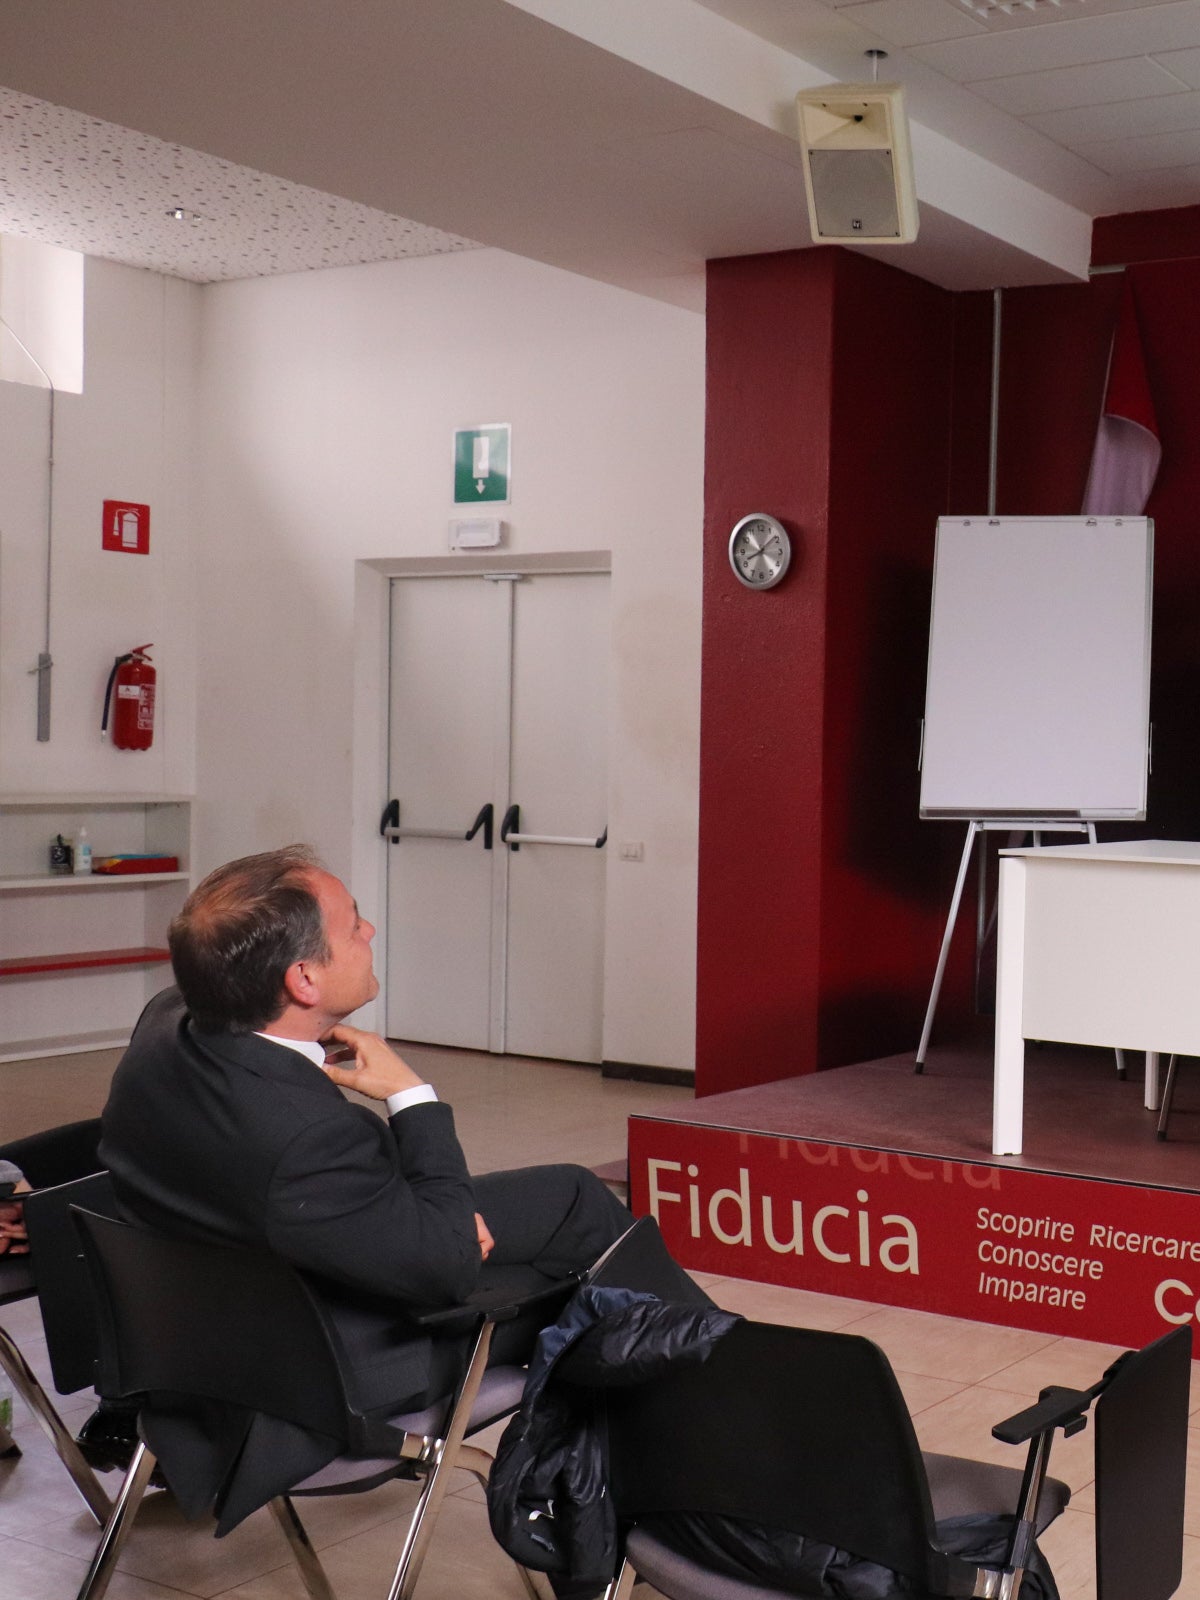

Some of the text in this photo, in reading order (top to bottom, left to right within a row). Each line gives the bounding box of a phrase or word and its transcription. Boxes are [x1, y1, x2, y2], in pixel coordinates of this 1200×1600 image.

[647, 1157, 920, 1276] Fiducia
[976, 1207, 1075, 1243] Scoprire
[977, 1240, 1104, 1280] Conoscere
[978, 1272, 1087, 1310] Imparare
